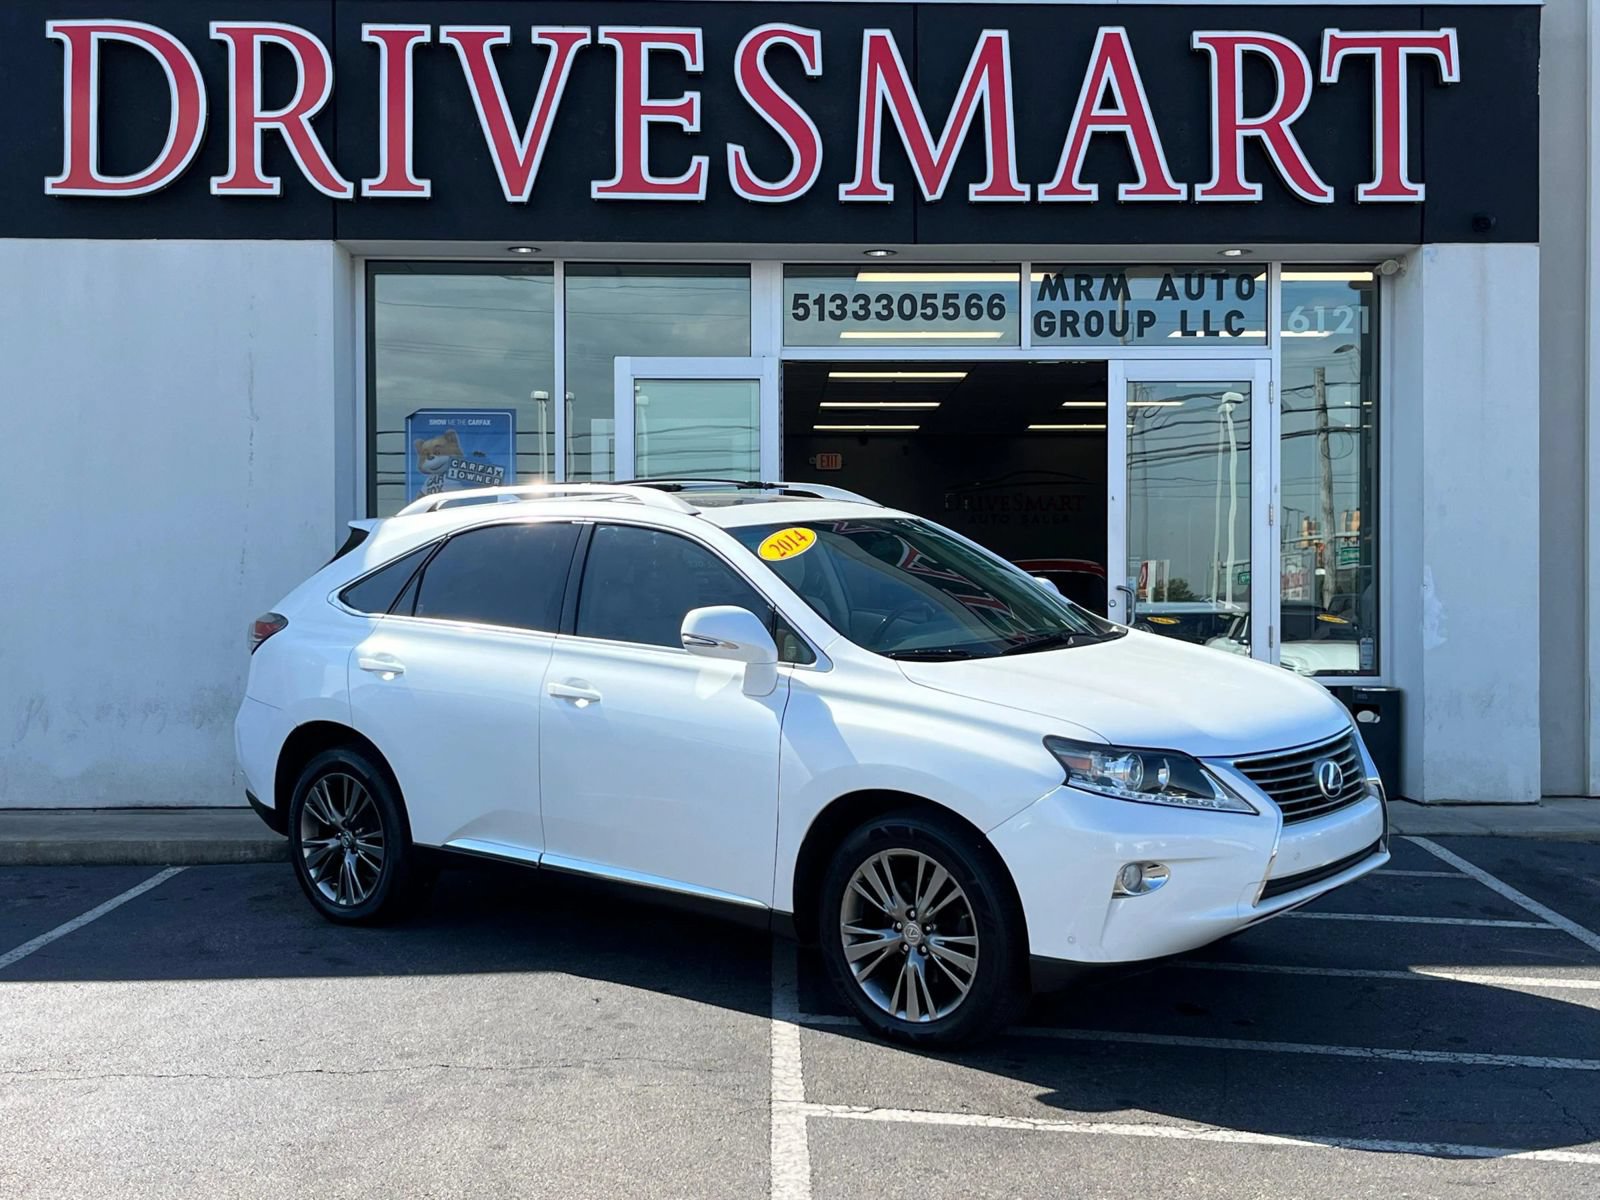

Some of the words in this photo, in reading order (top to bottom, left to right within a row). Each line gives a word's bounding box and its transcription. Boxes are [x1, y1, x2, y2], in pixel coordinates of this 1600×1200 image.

[45, 19, 1461, 204] DRIVESMART
[1037, 273, 1131, 301] MRM
[1155, 273, 1256, 301] AUTO
[791, 293, 1007, 322] 5133305566
[1287, 304, 1369, 334] 6121
[1033, 309, 1156, 338] GROUP
[1180, 309, 1246, 337] LLC
[467, 418, 491, 426] CARFAX
[451, 460, 504, 477] CARFAX
[768, 529, 808, 557] 2014
